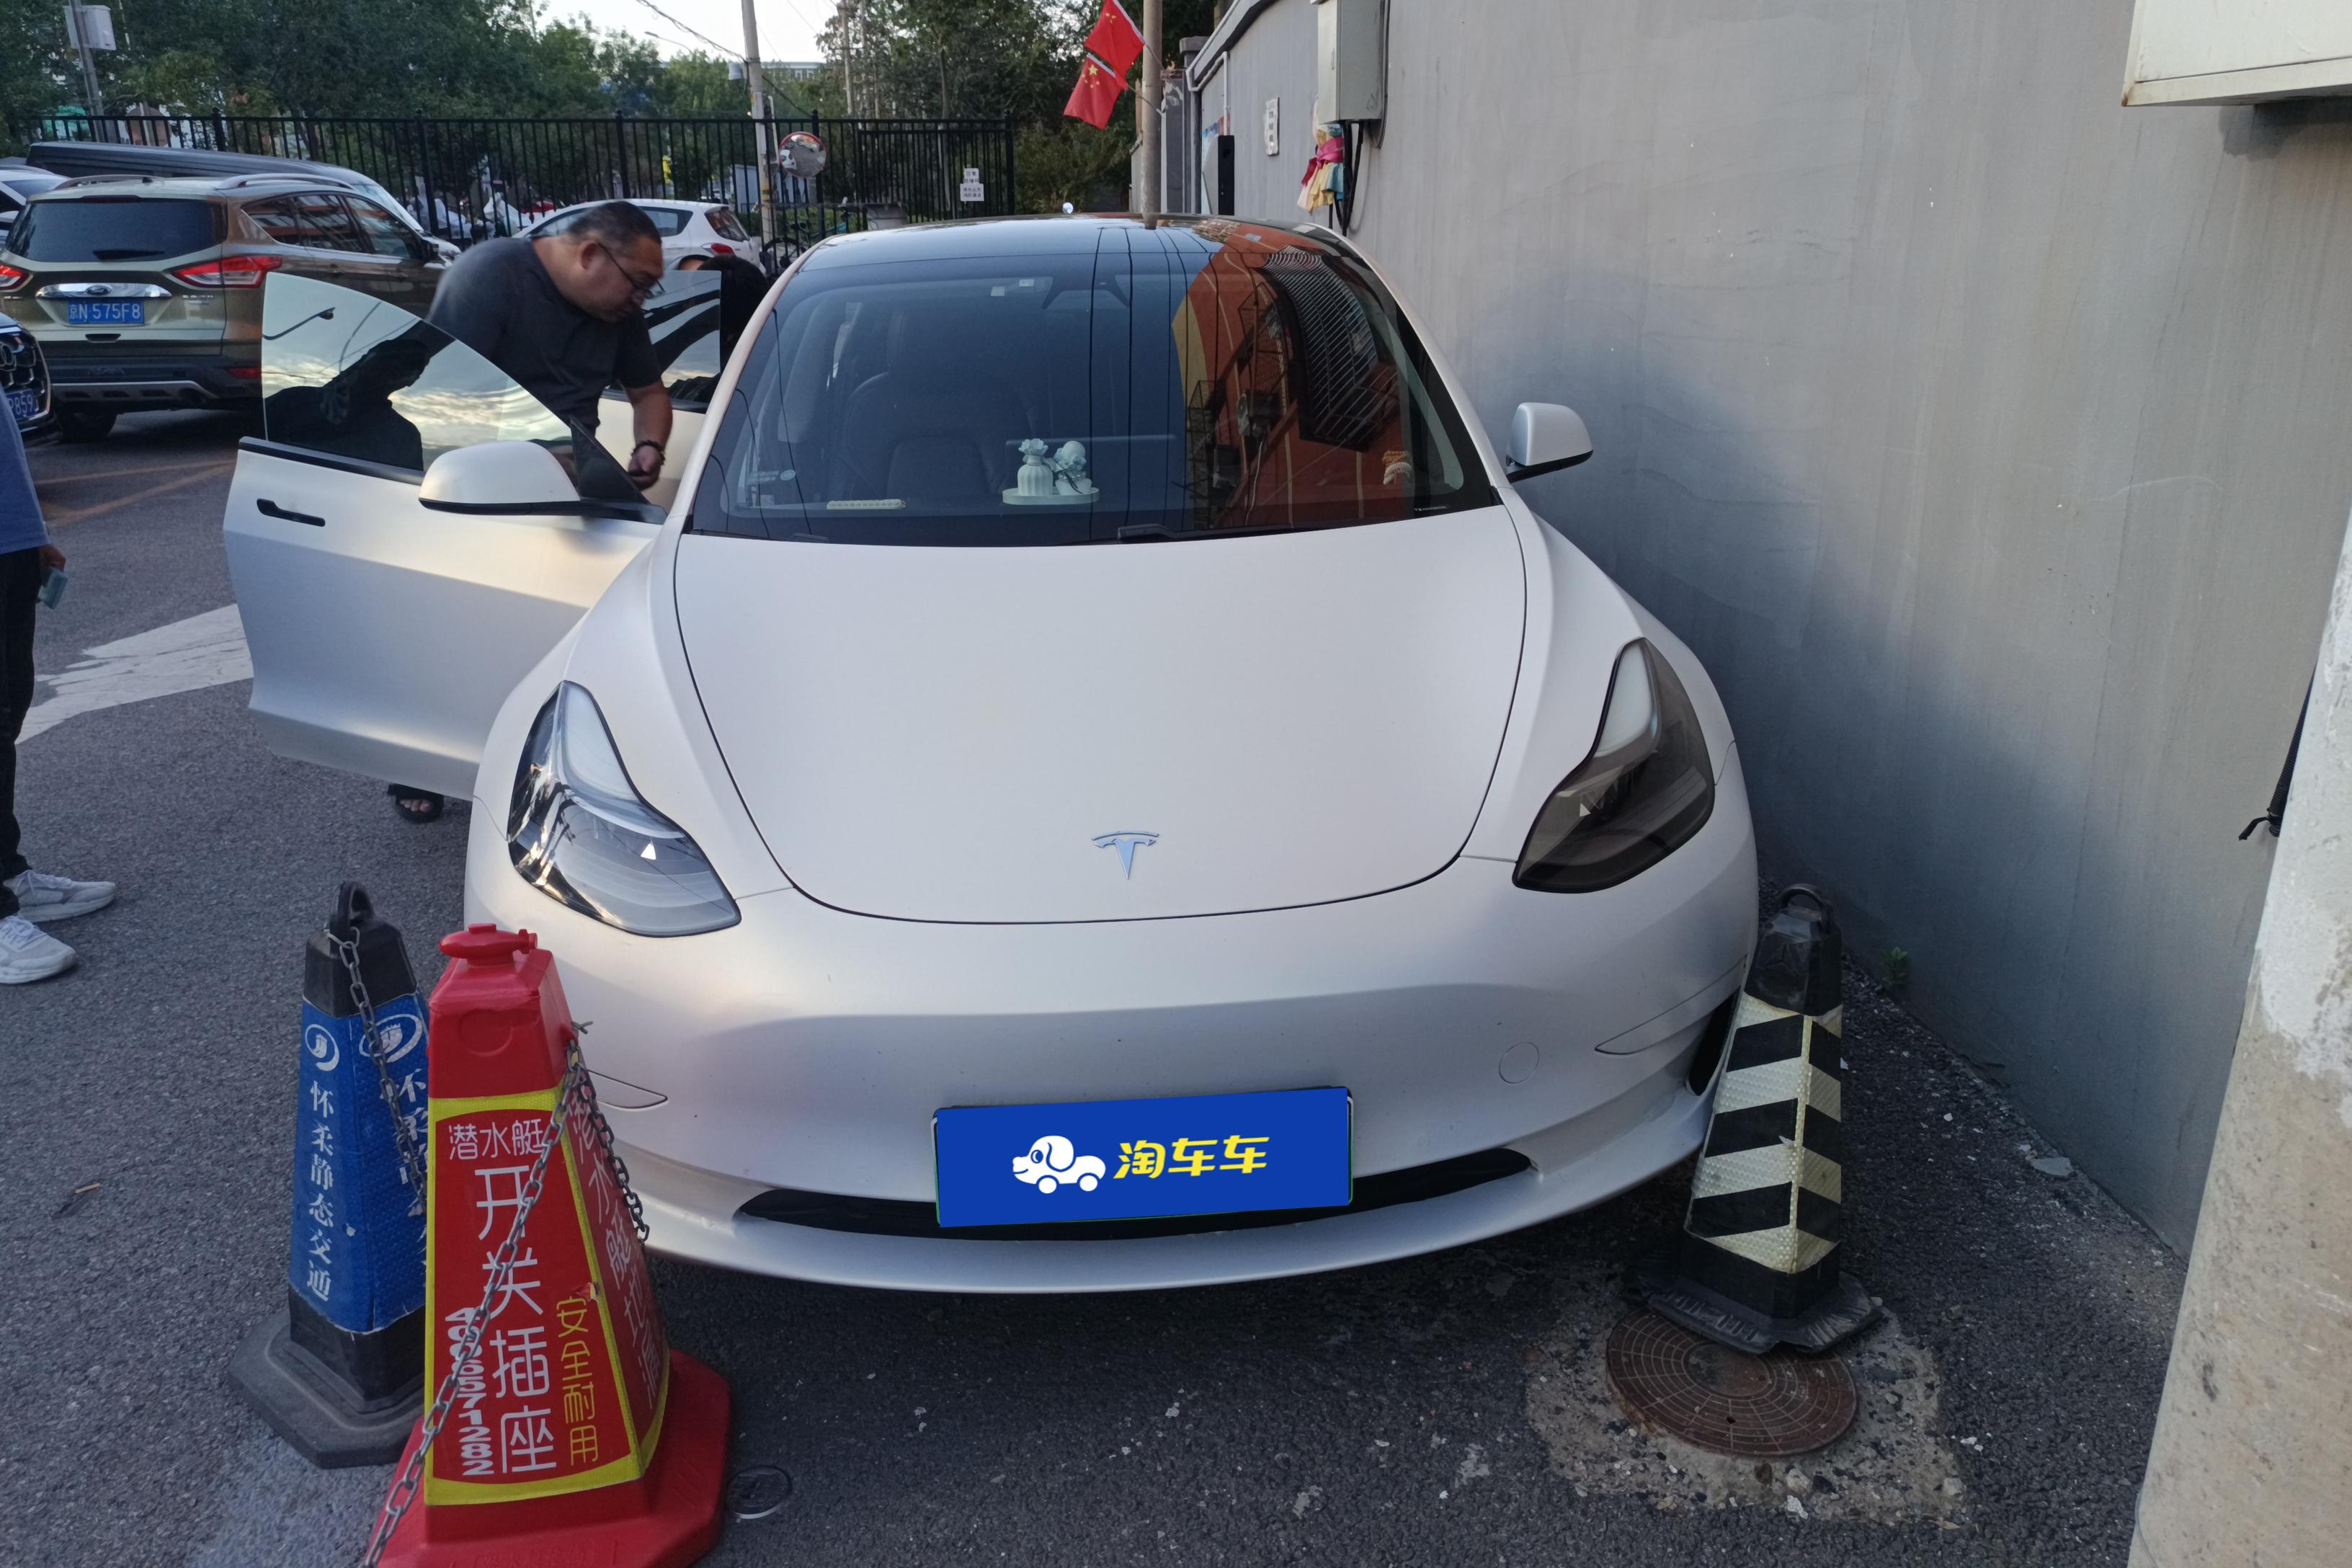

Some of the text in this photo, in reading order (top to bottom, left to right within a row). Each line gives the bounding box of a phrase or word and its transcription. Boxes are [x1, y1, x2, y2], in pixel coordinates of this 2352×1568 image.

[306, 1080, 334, 1302] 怀柔静态交通
[448, 1118, 544, 1160] 潜水艇
[474, 1164, 557, 1474] 开关插座
[556, 1295, 599, 1466] 安全耐用
